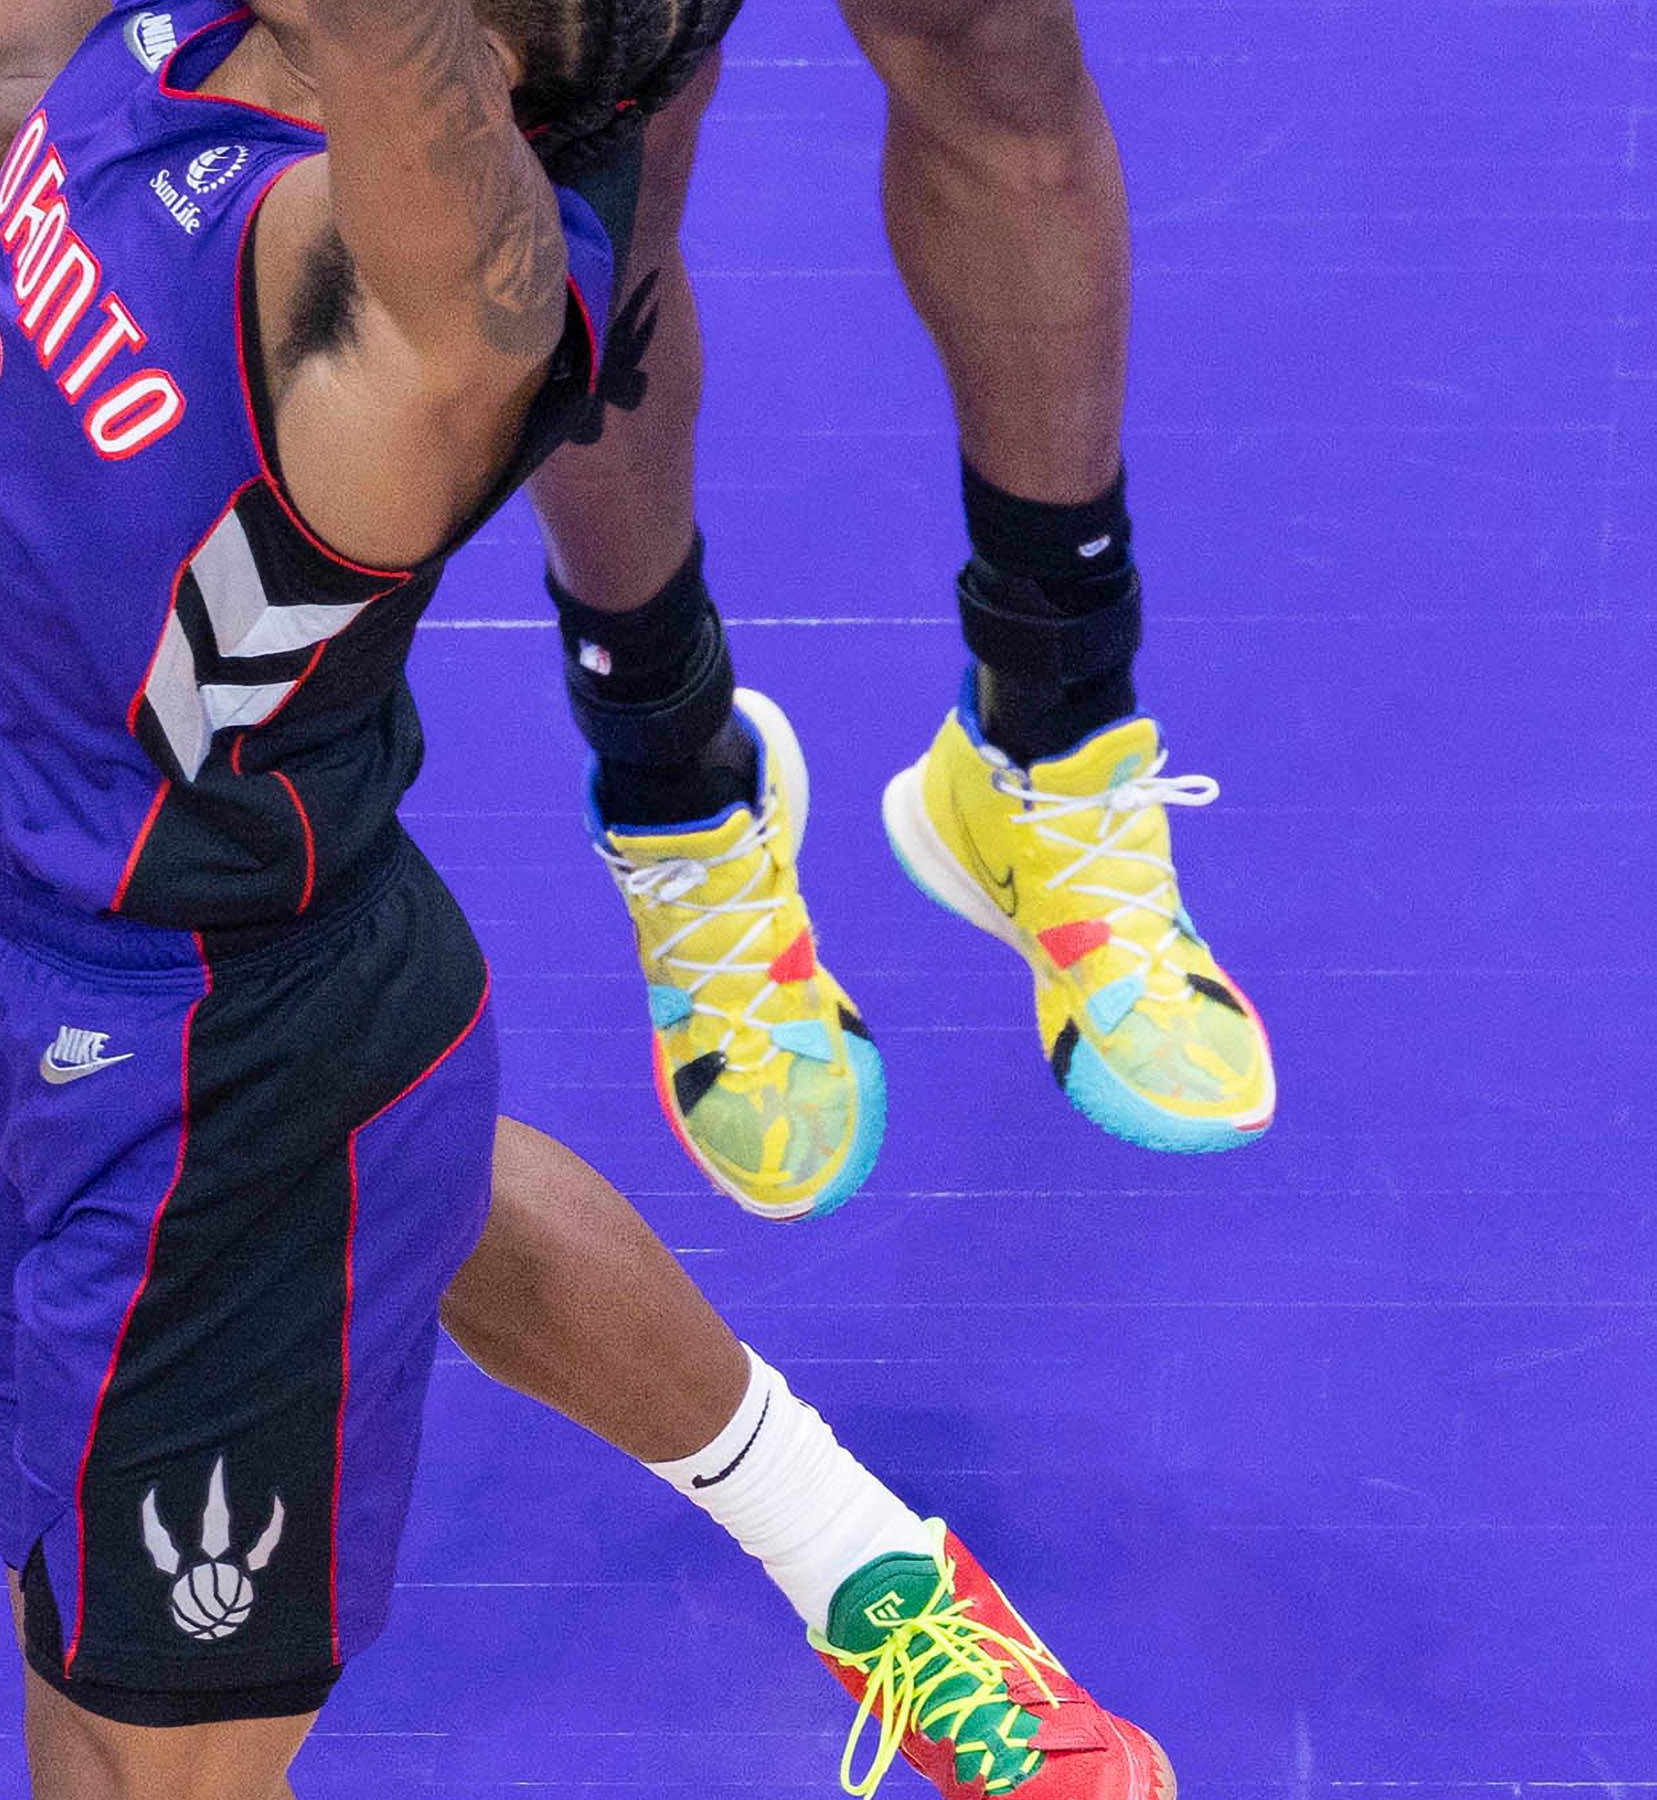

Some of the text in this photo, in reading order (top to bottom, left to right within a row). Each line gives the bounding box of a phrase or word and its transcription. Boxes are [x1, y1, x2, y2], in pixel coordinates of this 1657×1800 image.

[149, 169, 201, 236] Sun Life
[53, 1024, 111, 1065] NIKE
